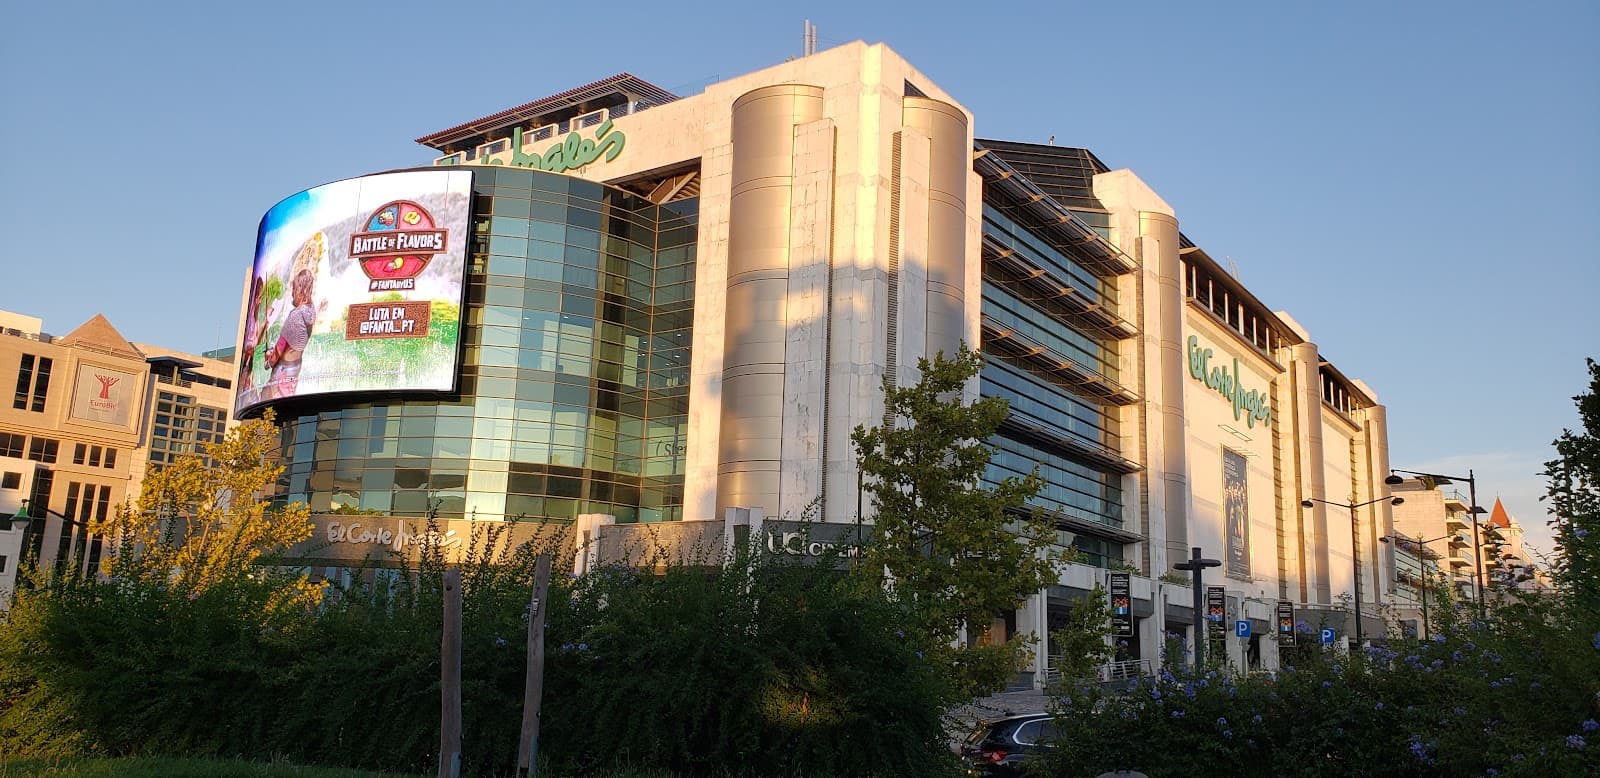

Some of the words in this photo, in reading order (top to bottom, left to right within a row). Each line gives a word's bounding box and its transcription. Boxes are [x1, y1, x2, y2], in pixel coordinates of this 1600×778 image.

[353, 236, 387, 254] BATTLE
[397, 232, 443, 250] FLAVORS
[369, 308, 389, 320] LUTA
[392, 307, 405, 319] EM
[360, 320, 415, 334] @FANTA_PT
[1188, 335, 1204, 382] El
[1203, 348, 1235, 402] Corte
[1233, 357, 1272, 429] Inglés
[326, 521, 346, 543] El
[347, 523, 392, 545] Corte
[1239, 623, 1247, 636] P
[1322, 629, 1332, 642] P
